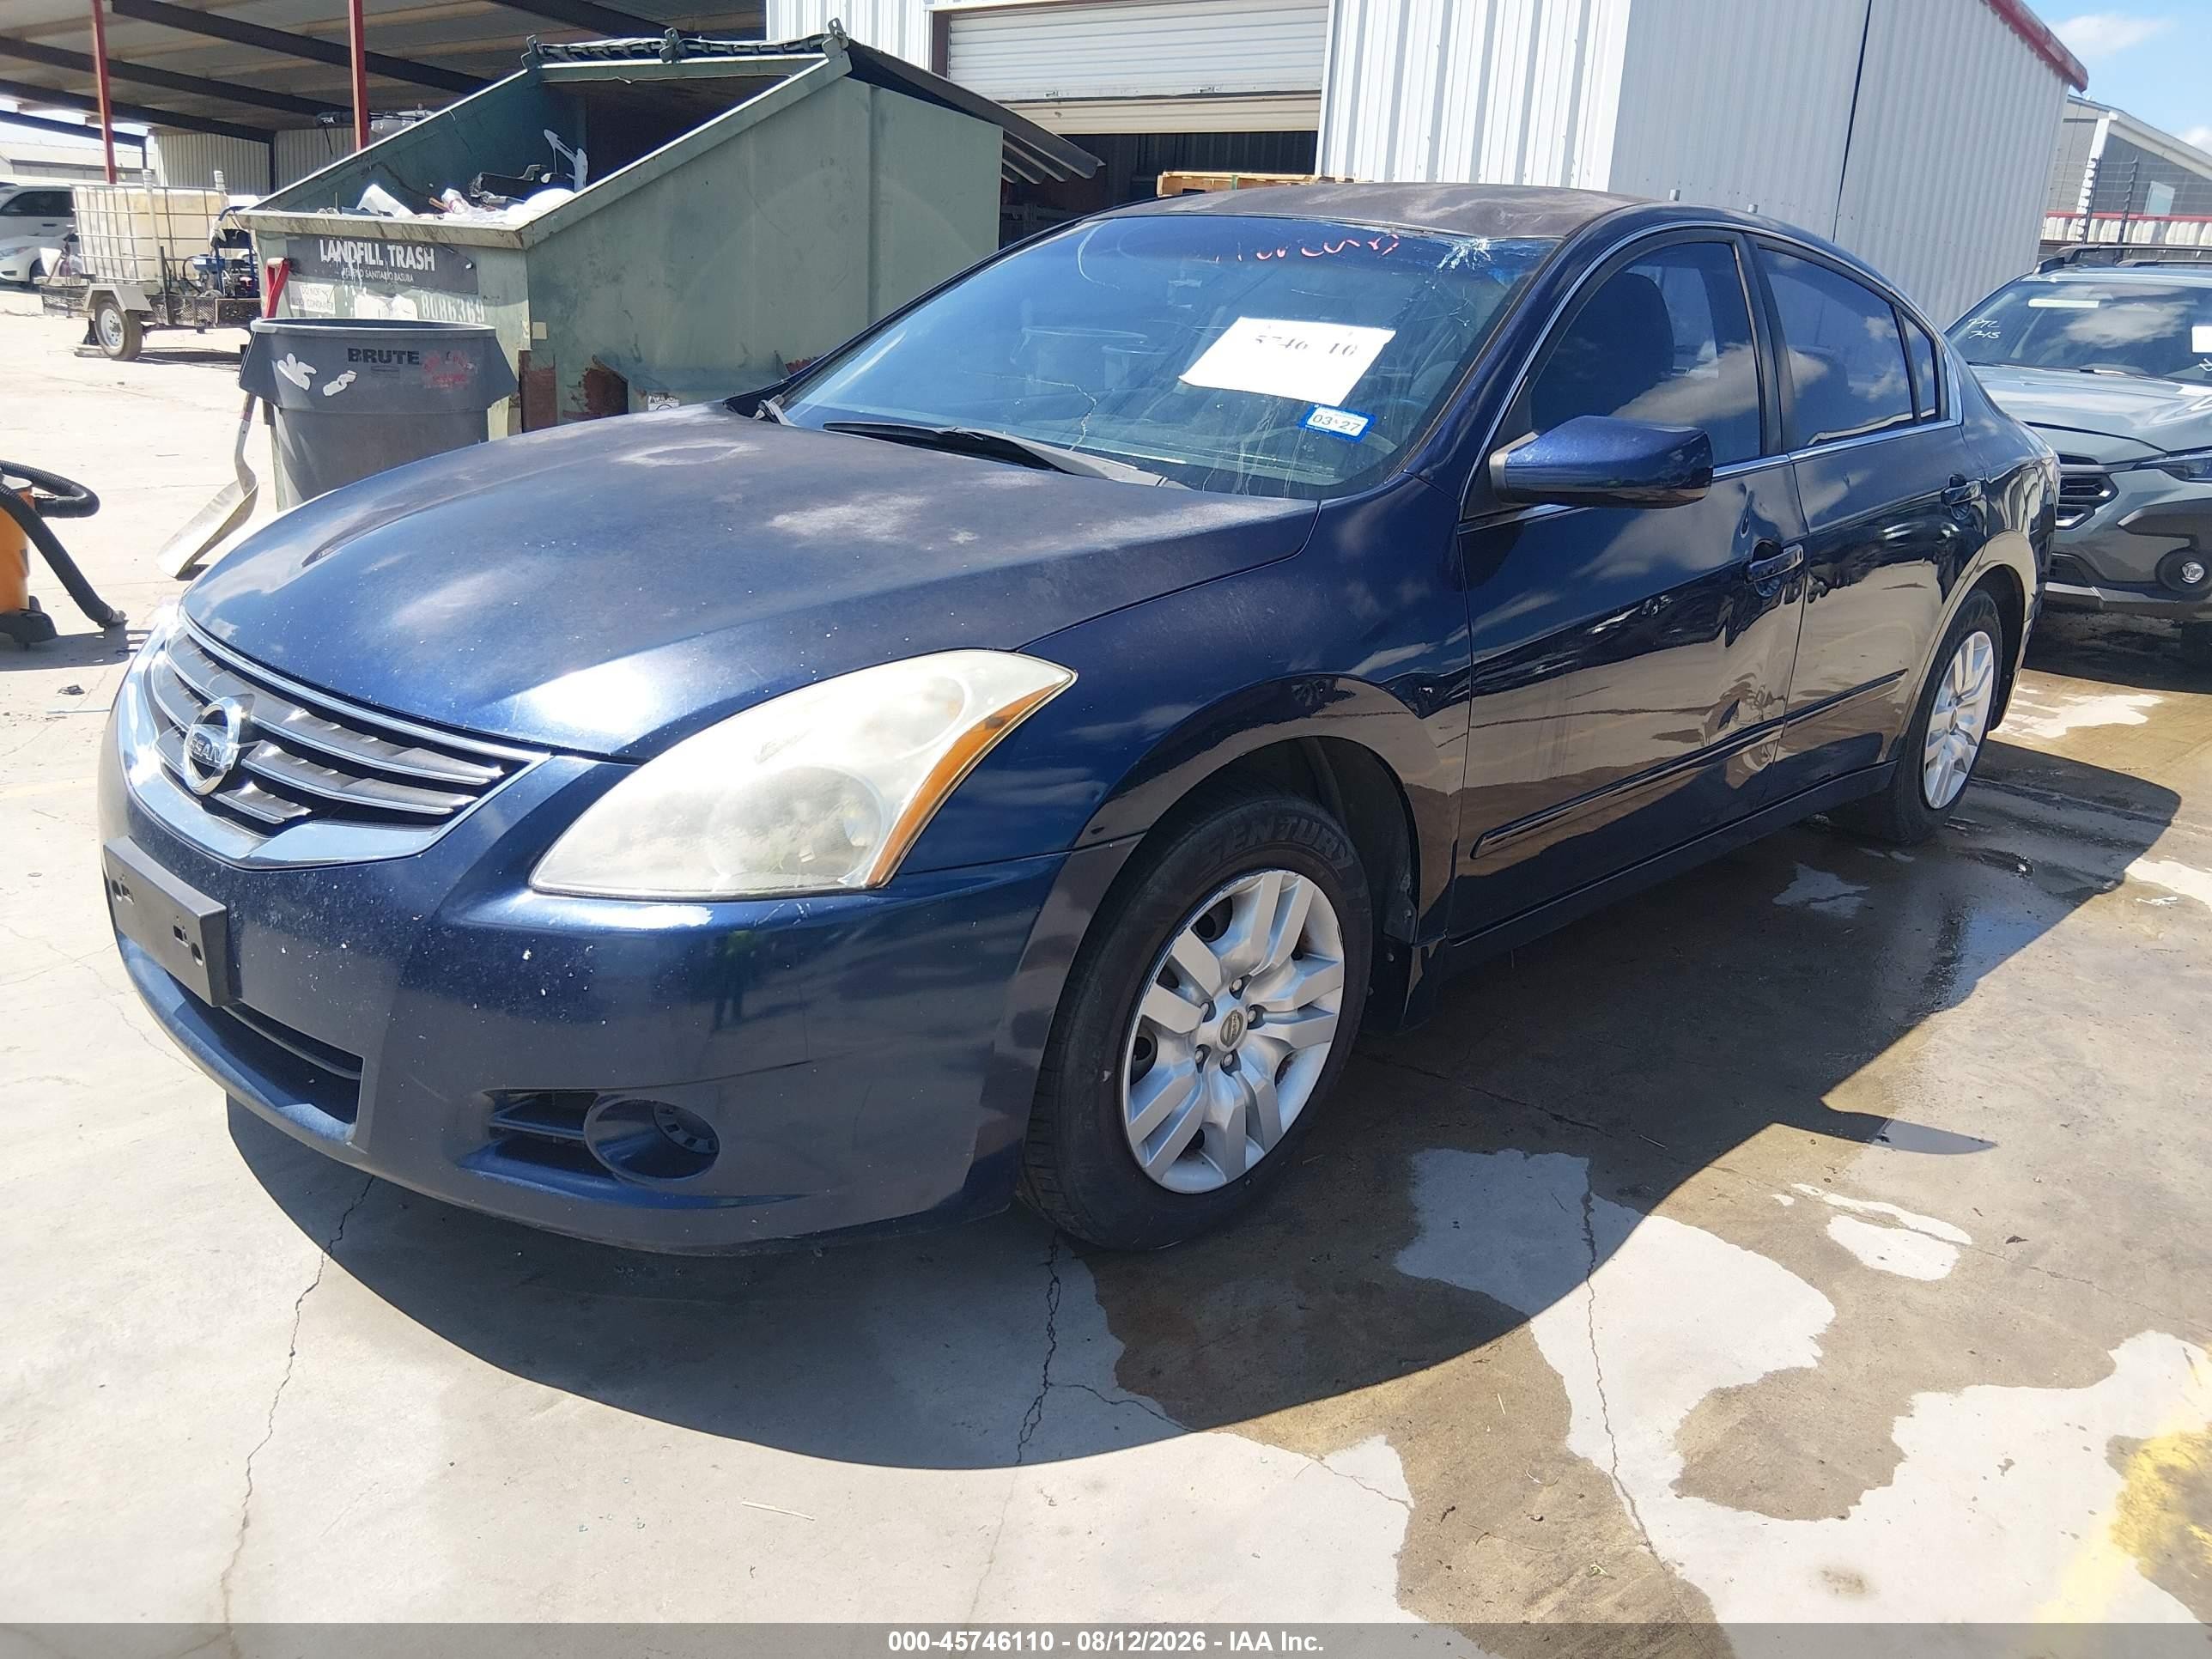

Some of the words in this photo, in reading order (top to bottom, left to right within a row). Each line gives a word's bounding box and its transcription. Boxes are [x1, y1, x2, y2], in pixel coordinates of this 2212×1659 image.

[319, 239, 386, 266] LANDFILL
[387, 244, 435, 271] TRASH
[347, 348, 420, 365] BRUTE
[1312, 414, 1333, 426] 03
[1338, 420, 1361, 432] 27
